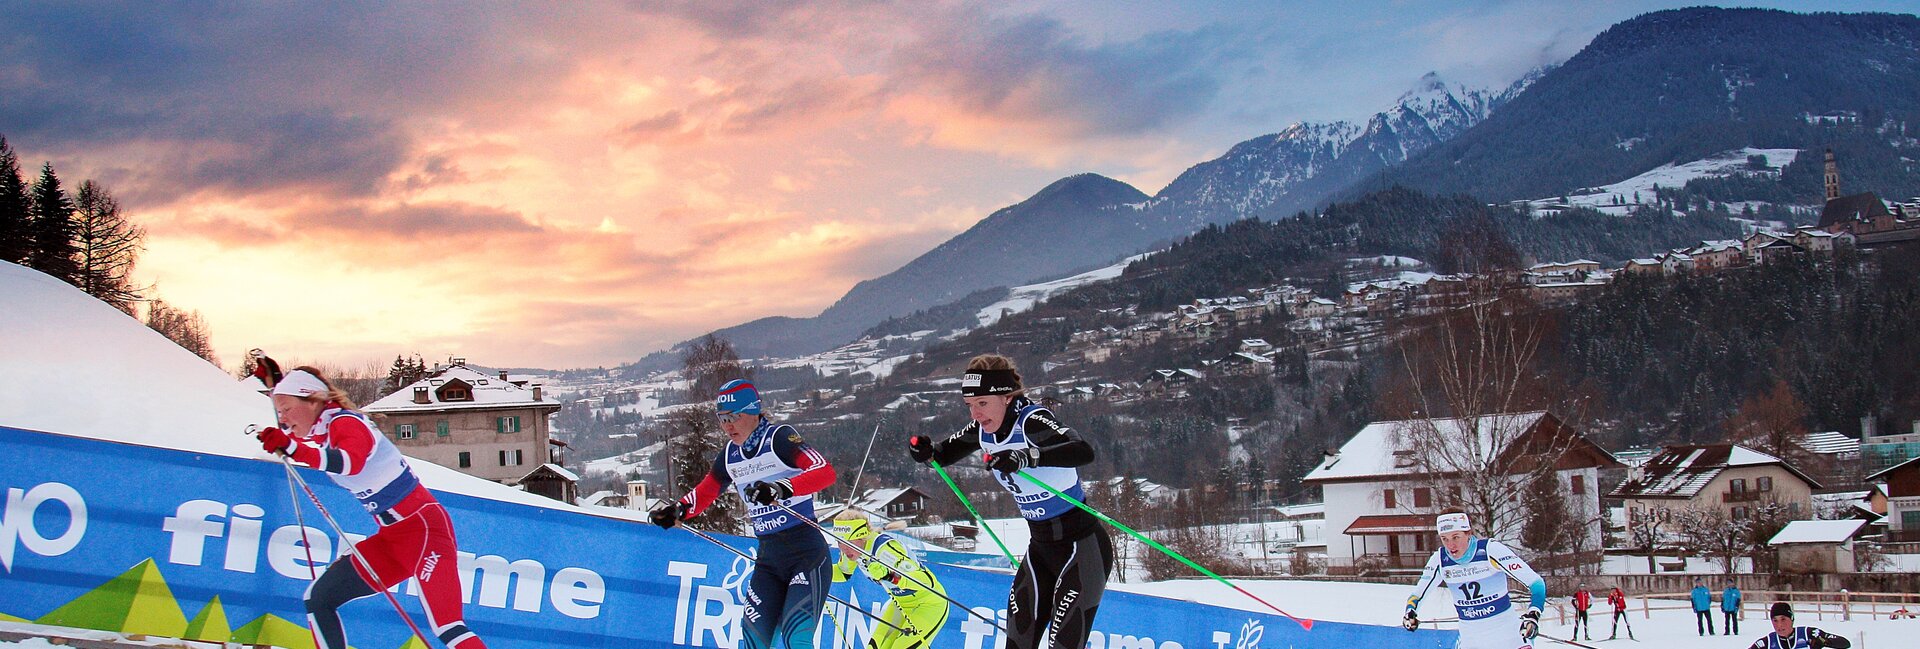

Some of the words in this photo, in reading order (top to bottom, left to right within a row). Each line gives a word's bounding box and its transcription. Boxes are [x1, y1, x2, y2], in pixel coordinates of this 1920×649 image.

[1000, 471, 1022, 494] 3
[163, 499, 606, 620] fieme
[1508, 563, 1522, 571] ICA
[1458, 581, 1484, 600] 12
